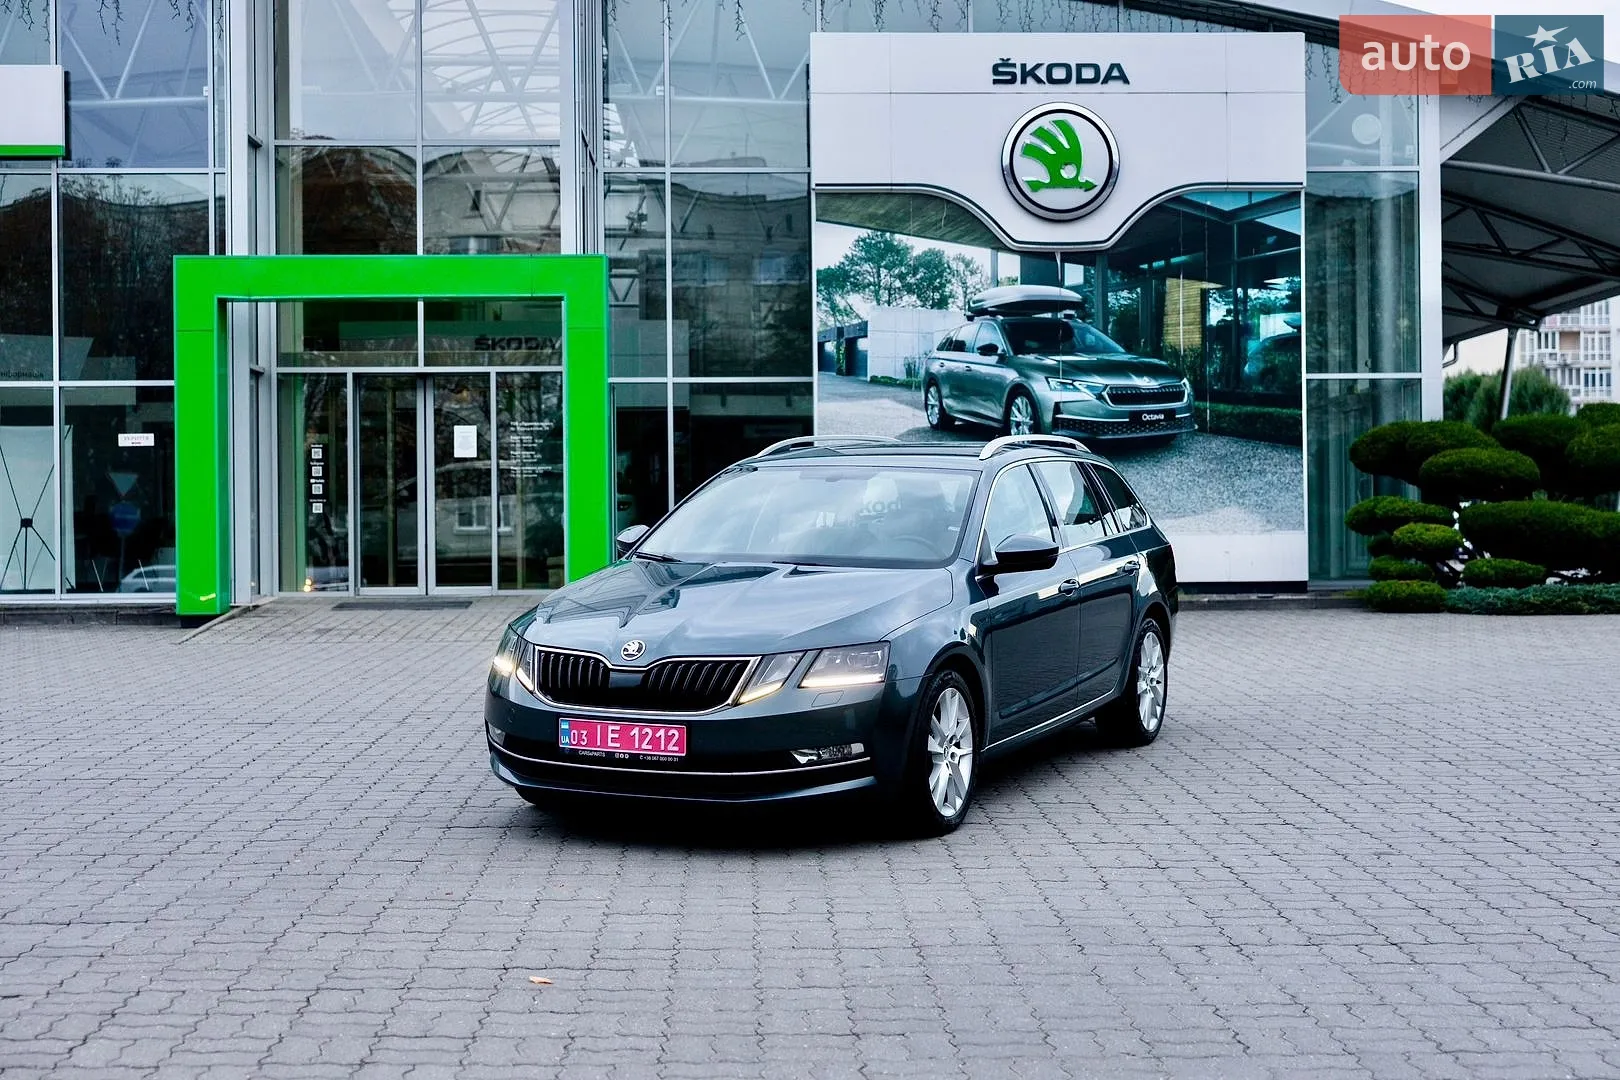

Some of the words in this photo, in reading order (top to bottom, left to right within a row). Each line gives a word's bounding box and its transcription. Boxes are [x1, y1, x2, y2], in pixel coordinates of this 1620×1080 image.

[992, 58, 1130, 85] ŠKODA
[1142, 413, 1164, 421] Octavia
[561, 735, 570, 744] UA
[570, 730, 588, 745] 03
[630, 727, 680, 751] 1212
